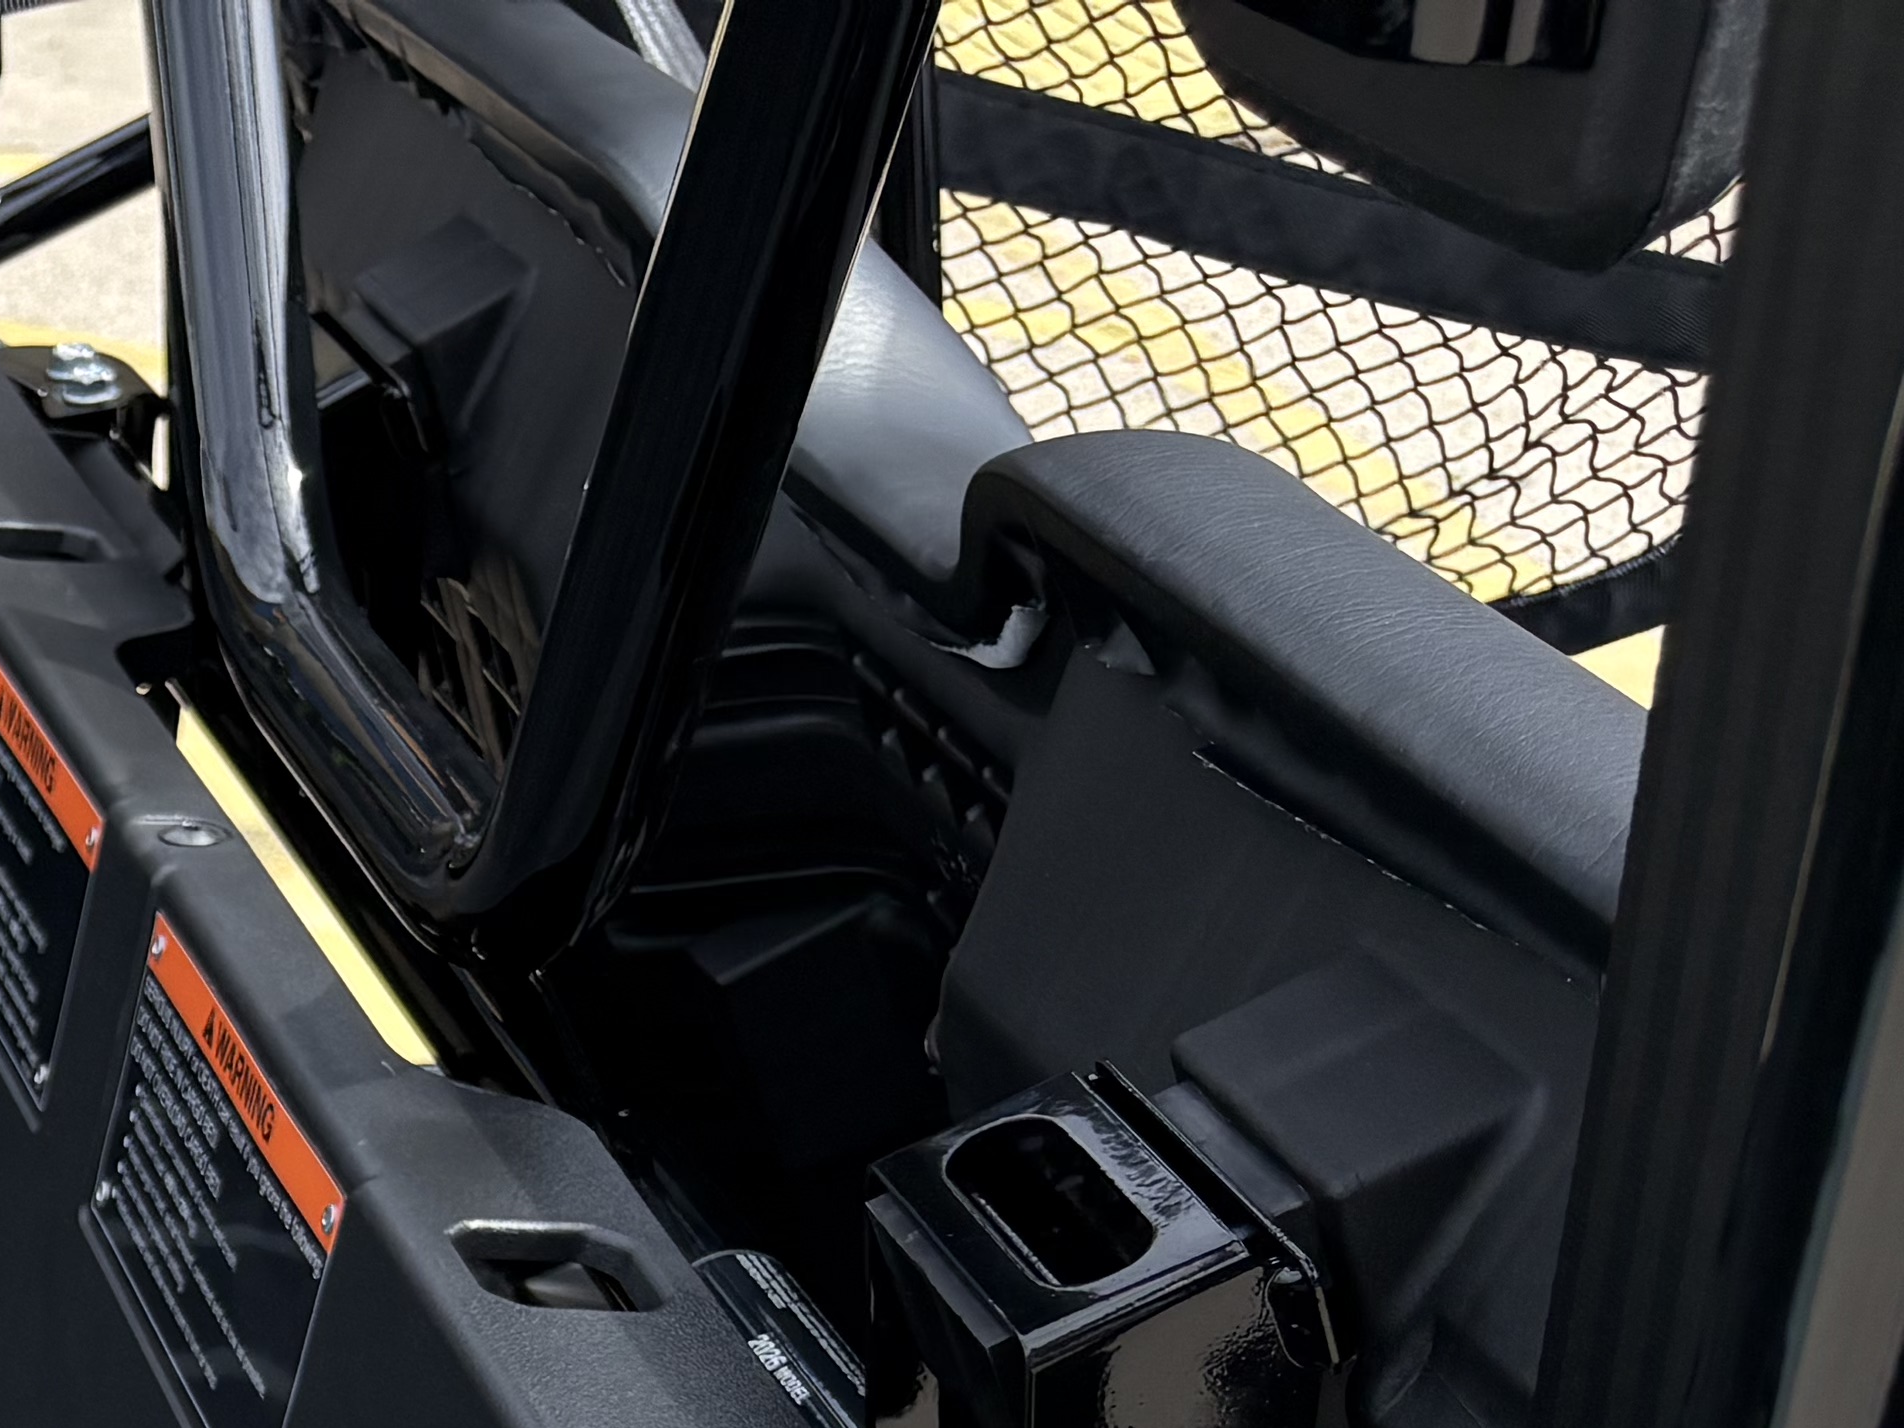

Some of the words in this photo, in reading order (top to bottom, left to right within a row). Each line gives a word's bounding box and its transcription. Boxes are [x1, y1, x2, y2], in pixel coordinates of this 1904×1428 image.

[5, 696, 57, 793] WARNING
[214, 1020, 276, 1146] WARNING
[748, 1334, 788, 1372] 2026
[773, 1365, 811, 1405] MODEL
